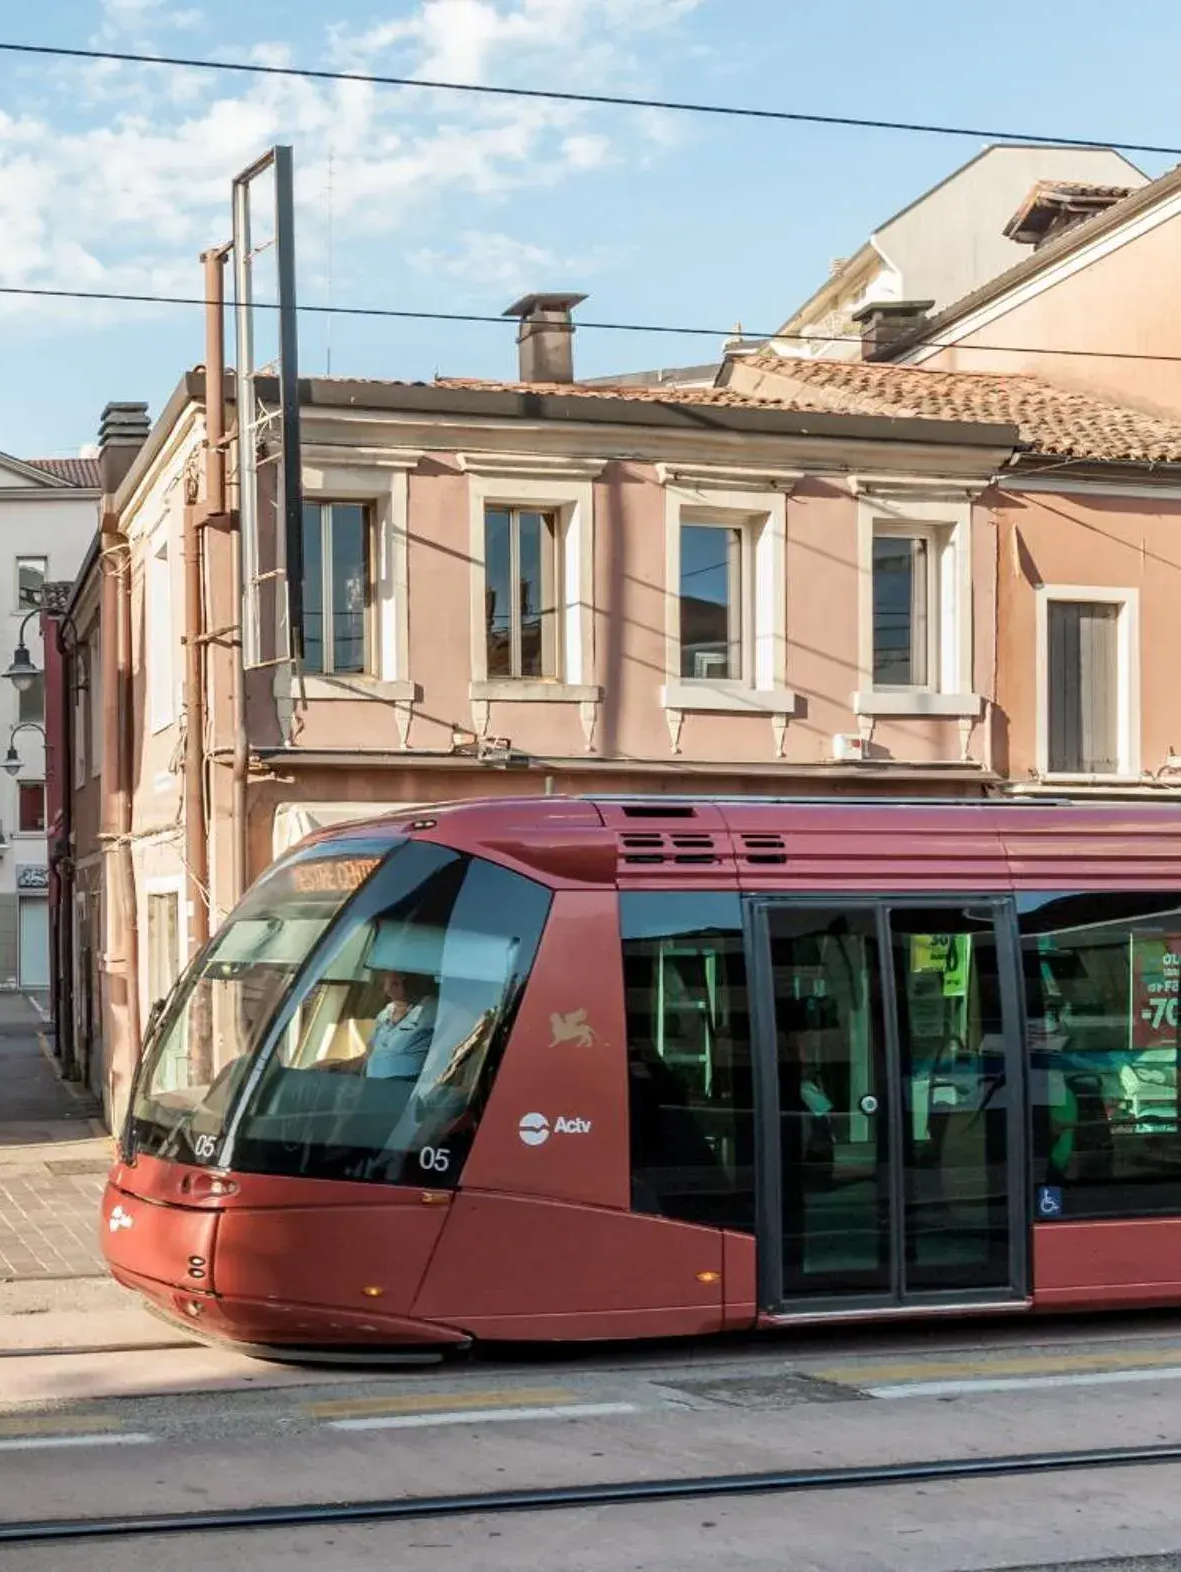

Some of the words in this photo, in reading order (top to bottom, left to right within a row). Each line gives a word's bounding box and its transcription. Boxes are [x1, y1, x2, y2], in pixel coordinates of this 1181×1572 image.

[554, 1116, 591, 1134] Actv
[195, 1134, 217, 1158] 05
[419, 1146, 451, 1171] 05
